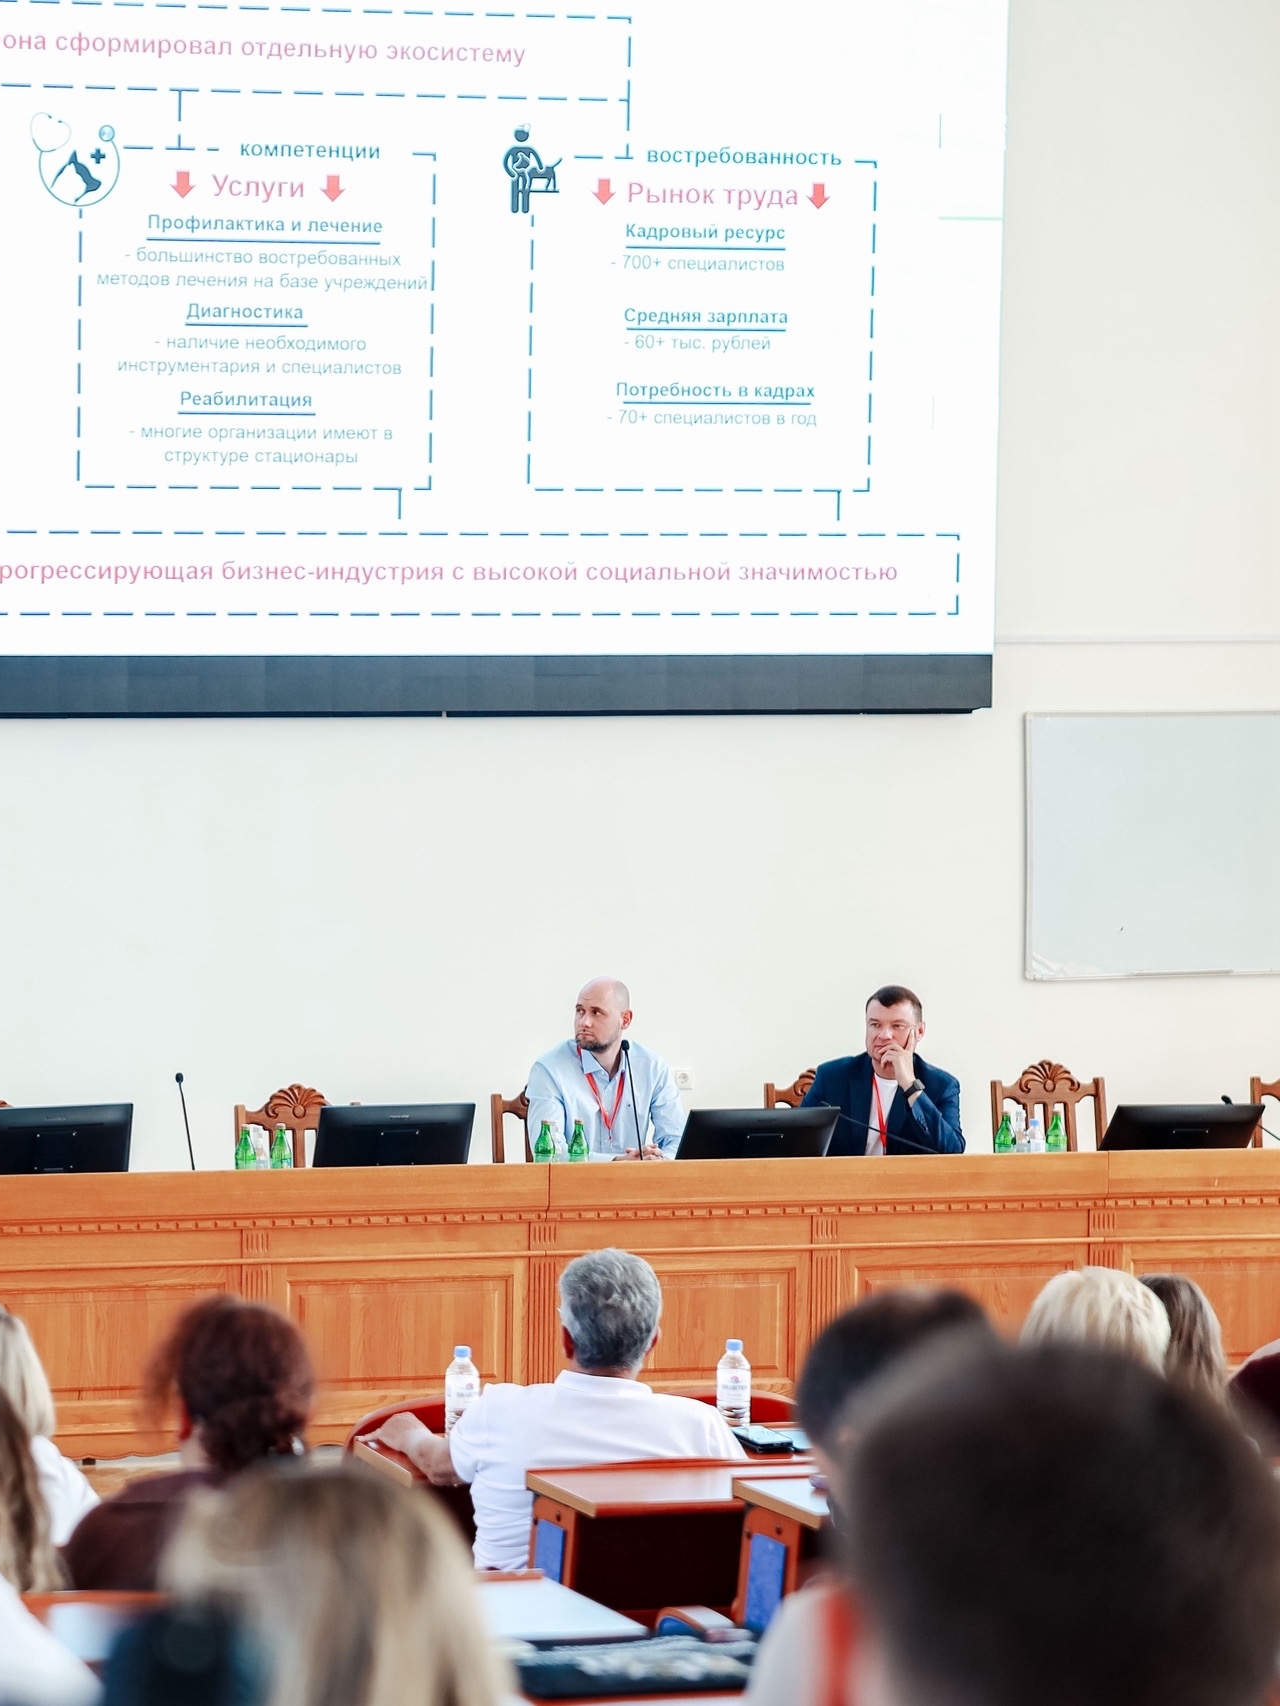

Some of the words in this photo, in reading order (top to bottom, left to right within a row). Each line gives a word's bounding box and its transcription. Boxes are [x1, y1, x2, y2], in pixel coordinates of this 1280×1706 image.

[56, 32, 231, 58] сформировал
[241, 41, 377, 63] отдельную
[387, 46, 525, 67] экосистему
[240, 143, 380, 162] компетенции
[647, 146, 842, 168] востребованность
[212, 174, 303, 203] Услуги
[628, 183, 714, 204] Рынок
[724, 189, 797, 210] труда
[148, 214, 284, 233] Профилактика
[291, 221, 301, 231] и
[308, 221, 382, 233] лечение
[626, 224, 718, 242] Кадровый
[724, 228, 785, 243] ресурс
[137, 247, 252, 263] большинство
[259, 250, 401, 268] востребованных
[623, 255, 661, 269] 700+
[668, 259, 784, 272] специалистов
[97, 274, 169, 287] методов
[176, 275, 247, 287] лечения
[254, 277, 273, 287] на
[280, 273, 318, 288] базе
[325, 276, 427, 292] учреждений
[186, 303, 303, 320] Диагностика
[624, 308, 701, 326] Средняя
[706, 312, 788, 328] зарплата
[167, 338, 239, 349] наличие
[246, 335, 366, 352] необходимого
[635, 334, 664, 348] 60+
[671, 339, 705, 349] тыс.
[712, 335, 770, 353] рублей
[118, 361, 259, 376] инструментария
[266, 363, 275, 373] и
[282, 363, 401, 375] специалистов
[180, 391, 312, 409] Реабилитация
[616, 382, 732, 401] Потребность
[738, 386, 748, 397] в
[754, 386, 815, 402] кадрах
[619, 410, 647, 424] 70+
[654, 414, 770, 426] специалистов
[777, 415, 785, 425] в
[792, 415, 817, 427] год
[141, 427, 202, 438] многие
[208, 428, 316, 442] организации
[323, 429, 377, 439] имеют
[384, 429, 392, 440] в
[165, 451, 248, 466] структуре
[255, 452, 357, 466] стационары
[222, 561, 443, 585] бизнес-индустрия
[453, 567, 464, 580] с
[474, 562, 577, 580] высокой
[586, 562, 730, 583] социальной
[739, 567, 897, 580] значимостью
